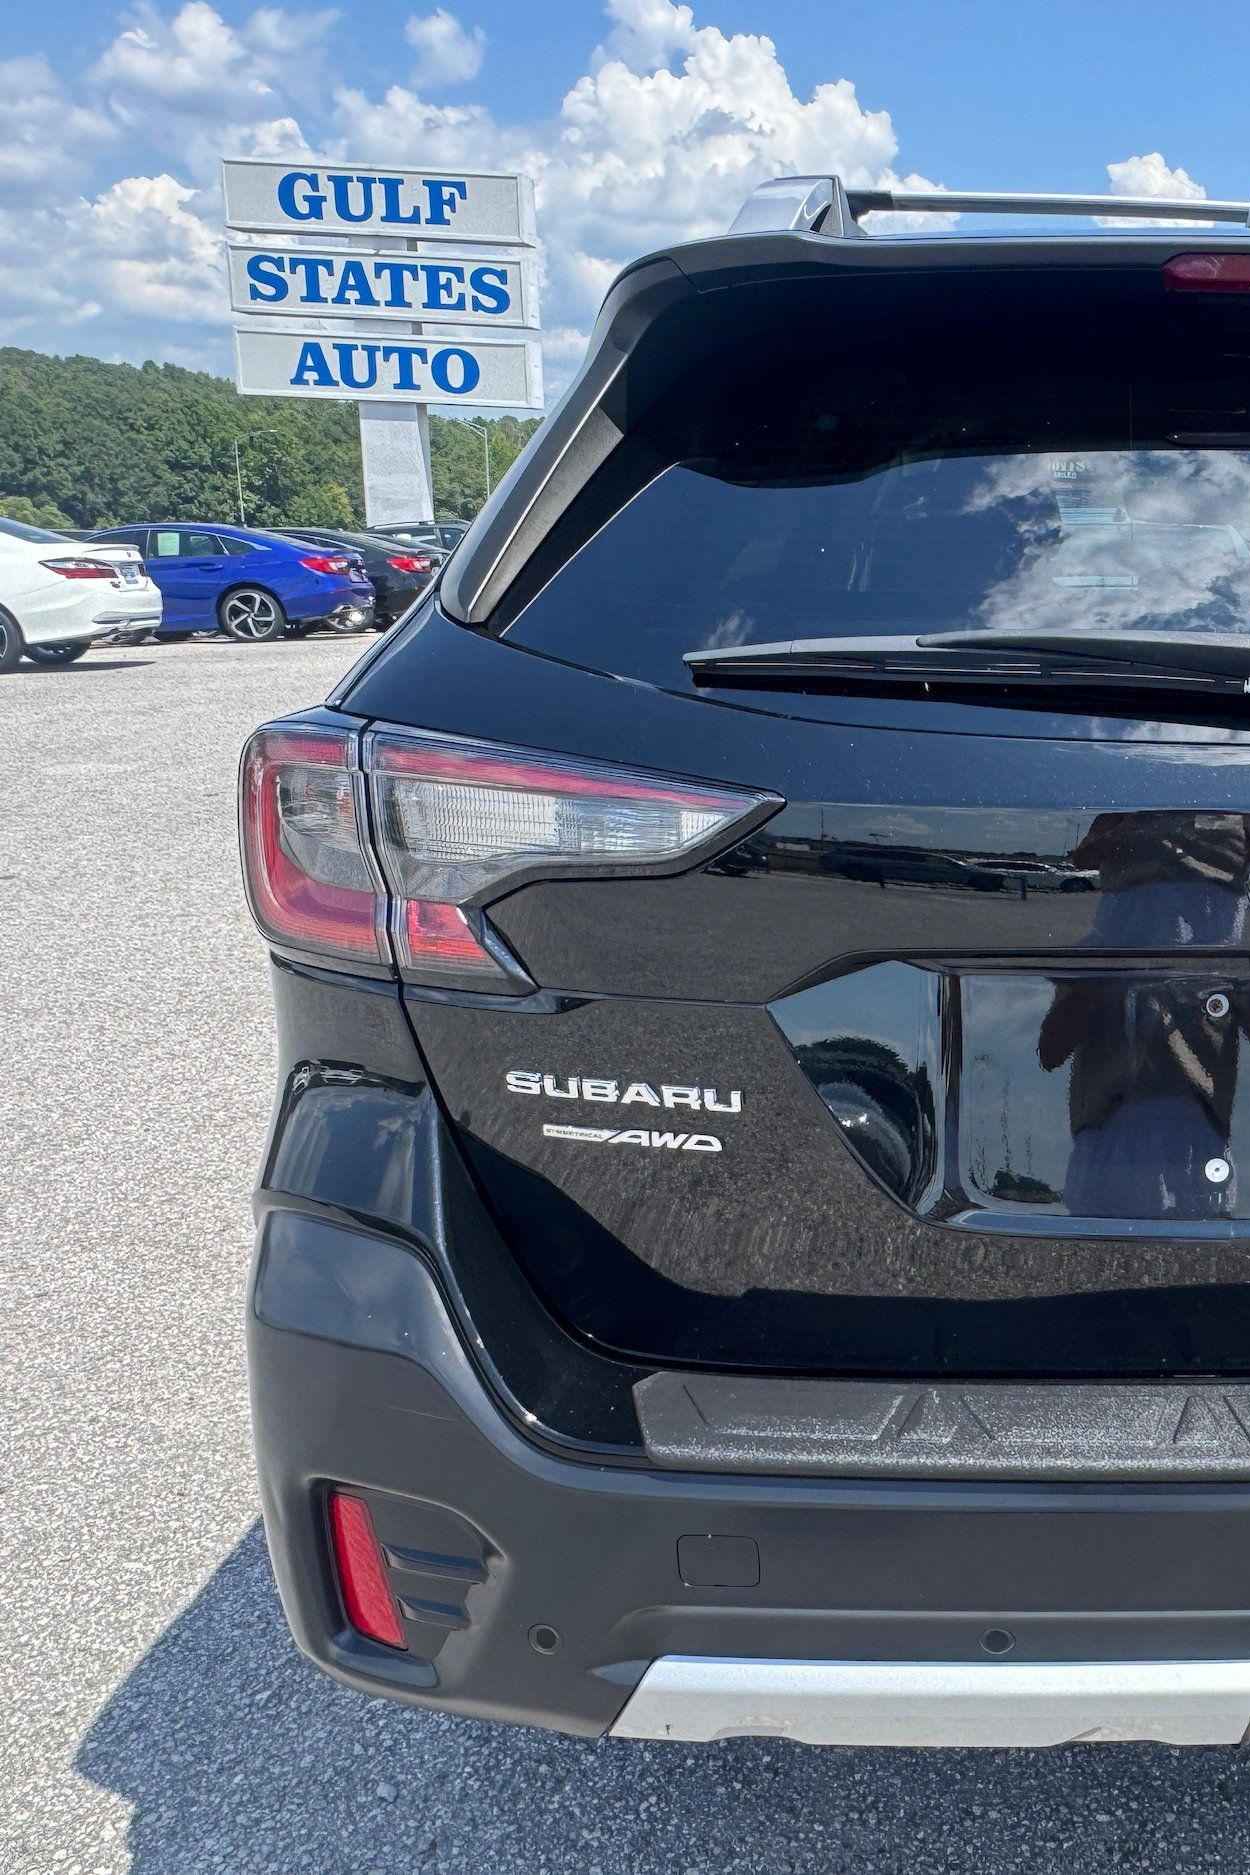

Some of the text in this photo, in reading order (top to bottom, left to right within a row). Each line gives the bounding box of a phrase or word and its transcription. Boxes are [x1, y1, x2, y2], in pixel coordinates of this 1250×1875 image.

[277, 172, 467, 225] GULF
[246, 254, 511, 314] STATES
[289, 341, 480, 394] AUTO
[505, 1070, 742, 1113] SUBARU
[609, 1129, 723, 1152] AWD
